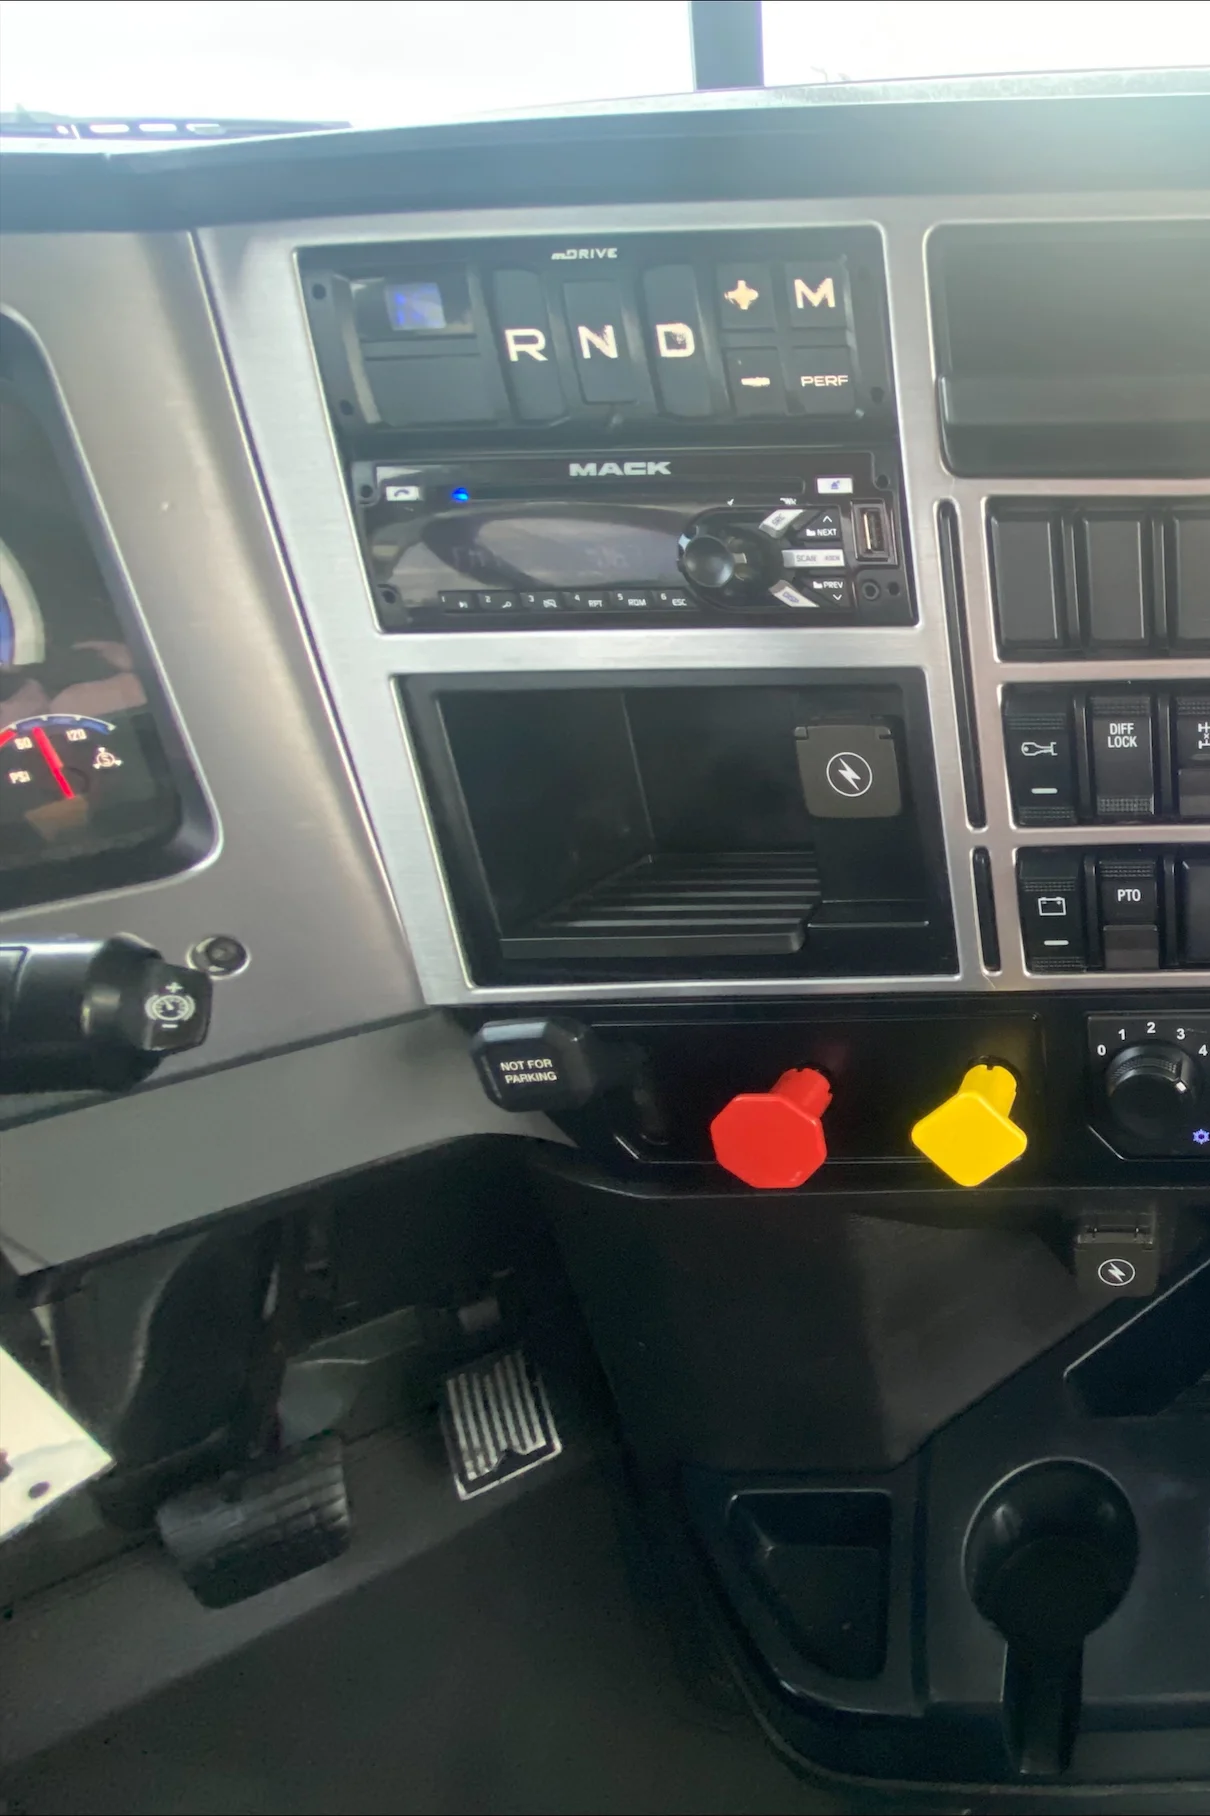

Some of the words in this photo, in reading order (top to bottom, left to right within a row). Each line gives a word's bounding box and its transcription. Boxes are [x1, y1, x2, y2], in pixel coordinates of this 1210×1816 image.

[794, 277, 836, 309] M
[504, 327, 548, 362] R
[577, 324, 619, 359] N
[655, 322, 696, 358] D
[801, 375, 849, 387] PERF
[569, 461, 672, 477] MACK
[816, 528, 837, 536] NEXT
[796, 554, 817, 562] SCAN
[823, 581, 844, 589] PREV
[660, 592, 667, 600] 6
[672, 598, 687, 606] ESC
[1109, 722, 1134, 735] DIFF
[1107, 735, 1138, 748] LOCK
[1117, 888, 1141, 902] PTO
[1118, 1028, 1126, 1040] 1
[1146, 1021, 1156, 1034] 2
[1176, 1027, 1186, 1040] 3
[1097, 1044, 1106, 1056] 0
[1198, 1044, 1208, 1056] 4
[500, 1060, 525, 1072] NOT
[527, 1058, 553, 1070] FOR
[504, 1071, 557, 1084] PARKING
